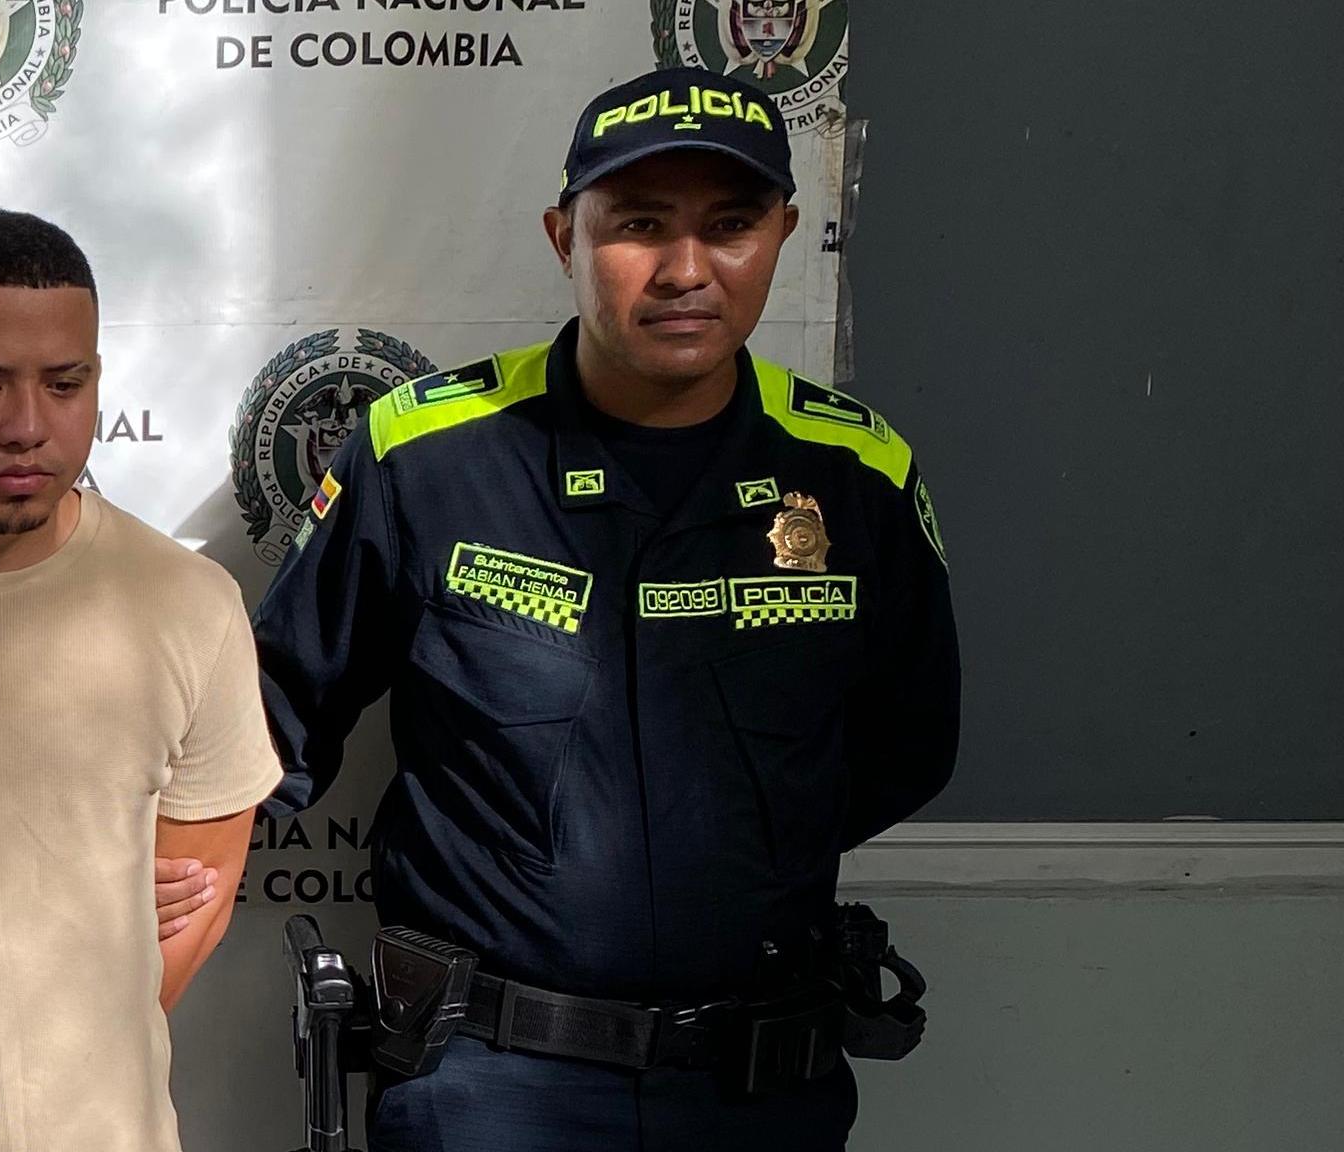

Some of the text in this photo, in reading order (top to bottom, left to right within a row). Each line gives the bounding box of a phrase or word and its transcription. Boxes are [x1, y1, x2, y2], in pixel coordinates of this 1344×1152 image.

[216, 31, 523, 69] DE COLOMBIA
[592, 86, 774, 138] POLICÍA
[338, 356, 361, 369] DE
[458, 565, 516, 588] FABIAN
[474, 553, 569, 586] Subintendente
[646, 581, 846, 611] 092099 POLICÍA
